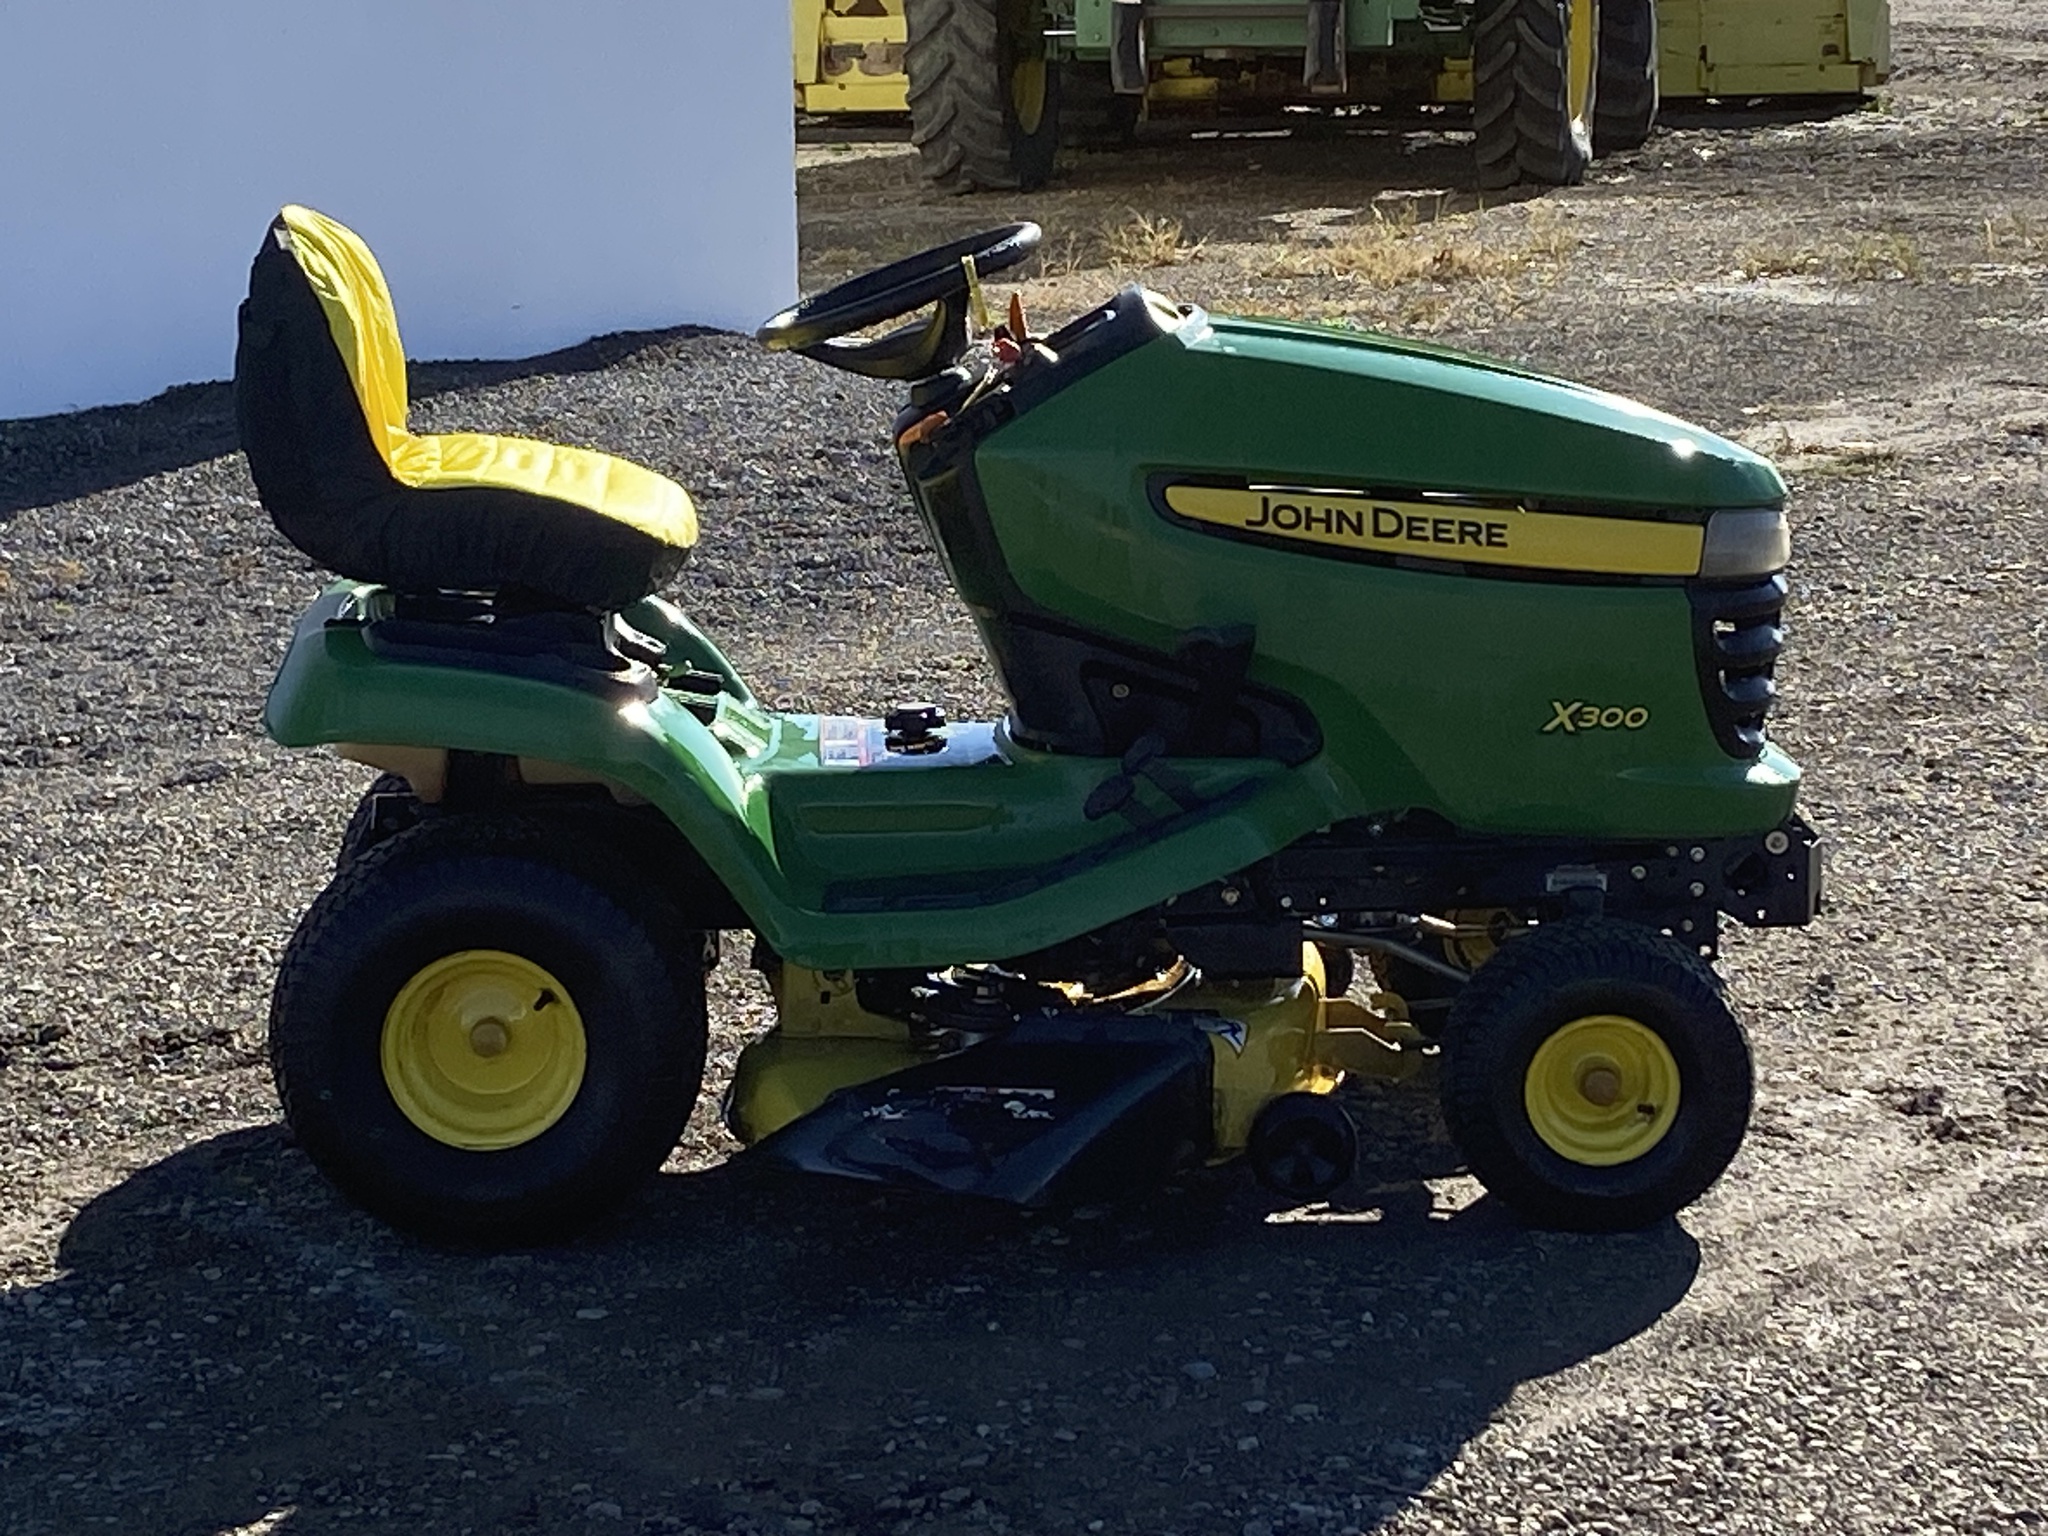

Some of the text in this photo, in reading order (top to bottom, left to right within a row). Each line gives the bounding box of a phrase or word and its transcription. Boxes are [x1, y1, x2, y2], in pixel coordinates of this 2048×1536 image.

[1245, 496, 1508, 548] JOHN DEERE
[1542, 700, 1649, 733] X300
